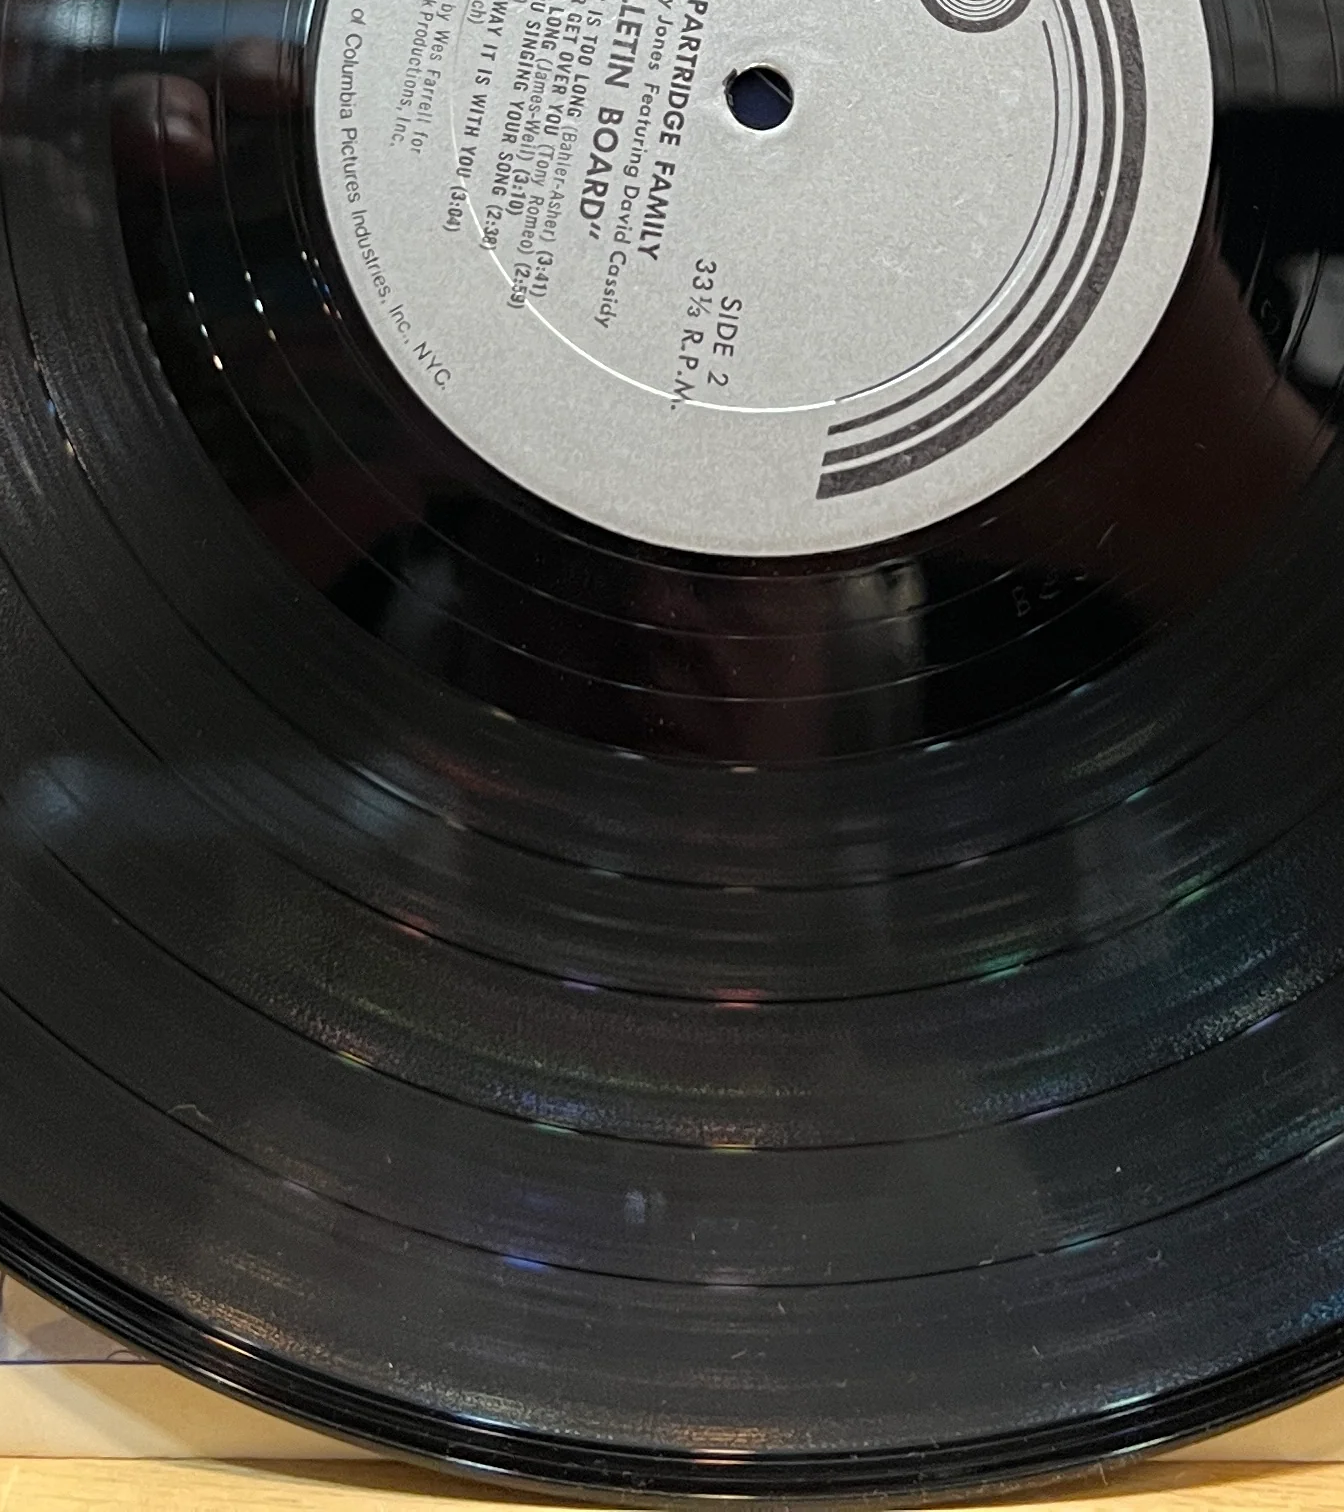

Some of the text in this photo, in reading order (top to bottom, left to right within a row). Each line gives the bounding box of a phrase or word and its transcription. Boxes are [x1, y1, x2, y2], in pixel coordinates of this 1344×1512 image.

[350, 8, 366, 25] of
[435, 3, 457, 22] by
[486, 1, 509, 37] WAY
[540, 6, 565, 51] LONG
[562, 12, 583, 45] GET
[586, 9, 604, 27] IS
[395, 10, 435, 111] Productions,
[429, 30, 451, 61] Wes
[480, 43, 498, 62] IT
[512, 20, 542, 92] SINGING
[577, 35, 599, 67] TOO
[647, 14, 674, 71] Jones
[339, 33, 363, 119] Columbia
[415, 69, 442, 124] Farrell
[474, 68, 493, 86] IS
[551, 51, 575, 95] OVER
[566, 73, 590, 118] LONG
[389, 116, 412, 147] Inc.
[463, 94, 488, 138] WITH
[500, 100, 526, 144] YOUR
[515, 58, 554, 162] (James-Weil)
[543, 104, 565, 137] YOU
[622, 82, 661, 178] Featuring
[340, 127, 361, 204] Pictures
[410, 131, 429, 155] for
[455, 146, 477, 179] YOU
[530, 143, 556, 187] (Tony
[491, 151, 514, 197] SONG
[504, 168, 531, 216] (3:10)
[538, 125, 579, 243] (Bahler-Asher)
[579, 106, 625, 240] BOARD"
[442, 185, 468, 233] (3:04)
[478, 204, 504, 251] (2:38)
[516, 194, 545, 256] Romeo)
[613, 184, 641, 245] David
[637, 160, 676, 261] FAMILY
[351, 209, 392, 304] Industries,
[528, 250, 554, 298] (3:41)
[593, 250, 627, 329] Cassidy
[707, 295, 743, 387] SIDE 2
[670, 328, 705, 411] R.P.M.
